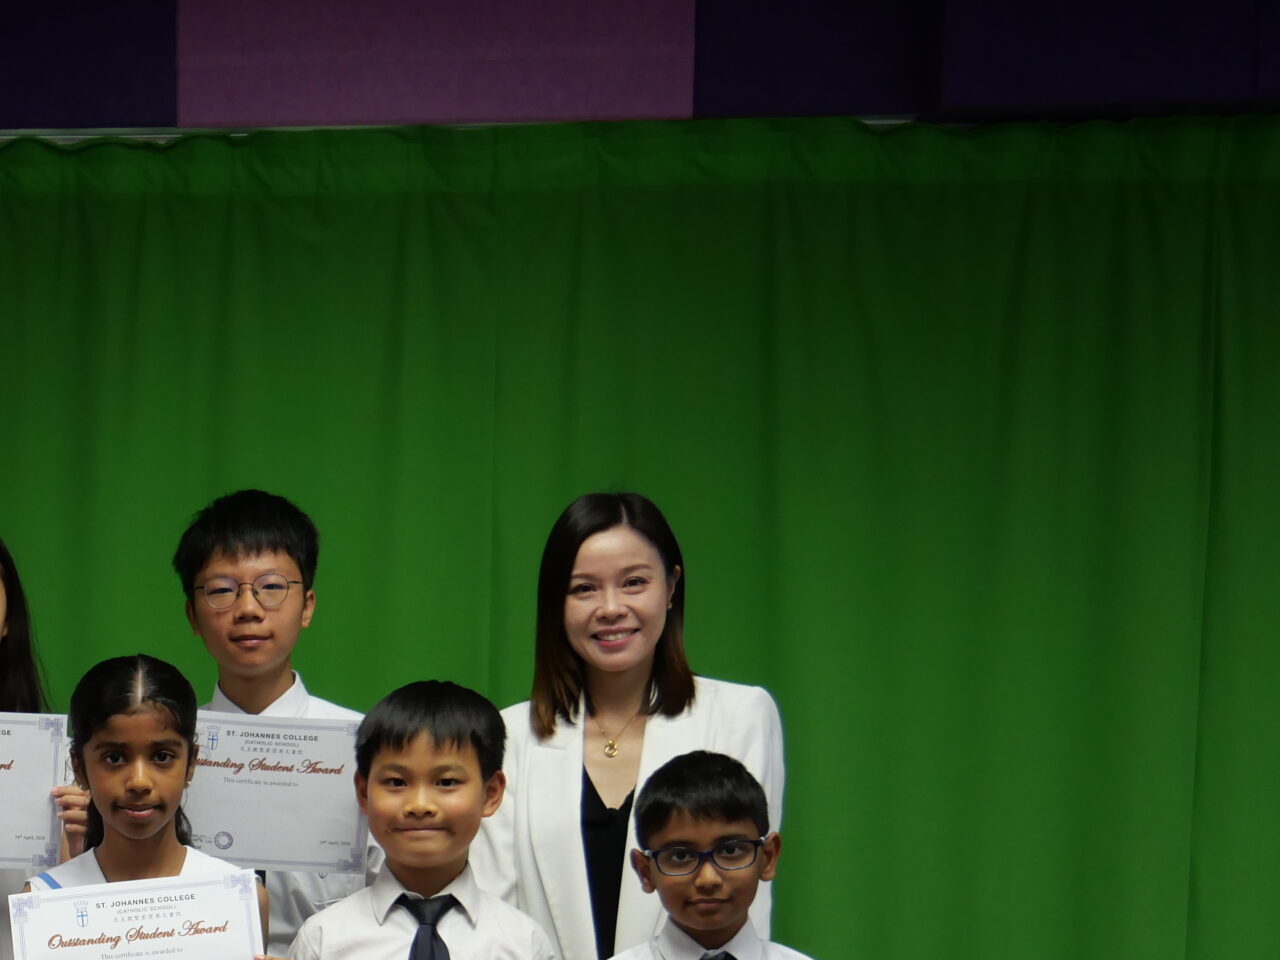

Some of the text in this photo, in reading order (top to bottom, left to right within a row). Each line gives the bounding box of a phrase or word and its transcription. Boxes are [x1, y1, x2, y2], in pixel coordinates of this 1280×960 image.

[248, 757, 294, 772] Student
[296, 759, 344, 775] Award
[111, 898, 154, 907] JOHANNES
[157, 894, 195, 902] COLLEGE
[48, 920, 228, 950] Outstanding Student Award
[115, 951, 143, 959] certificate
[152, 947, 175, 955] awarded
